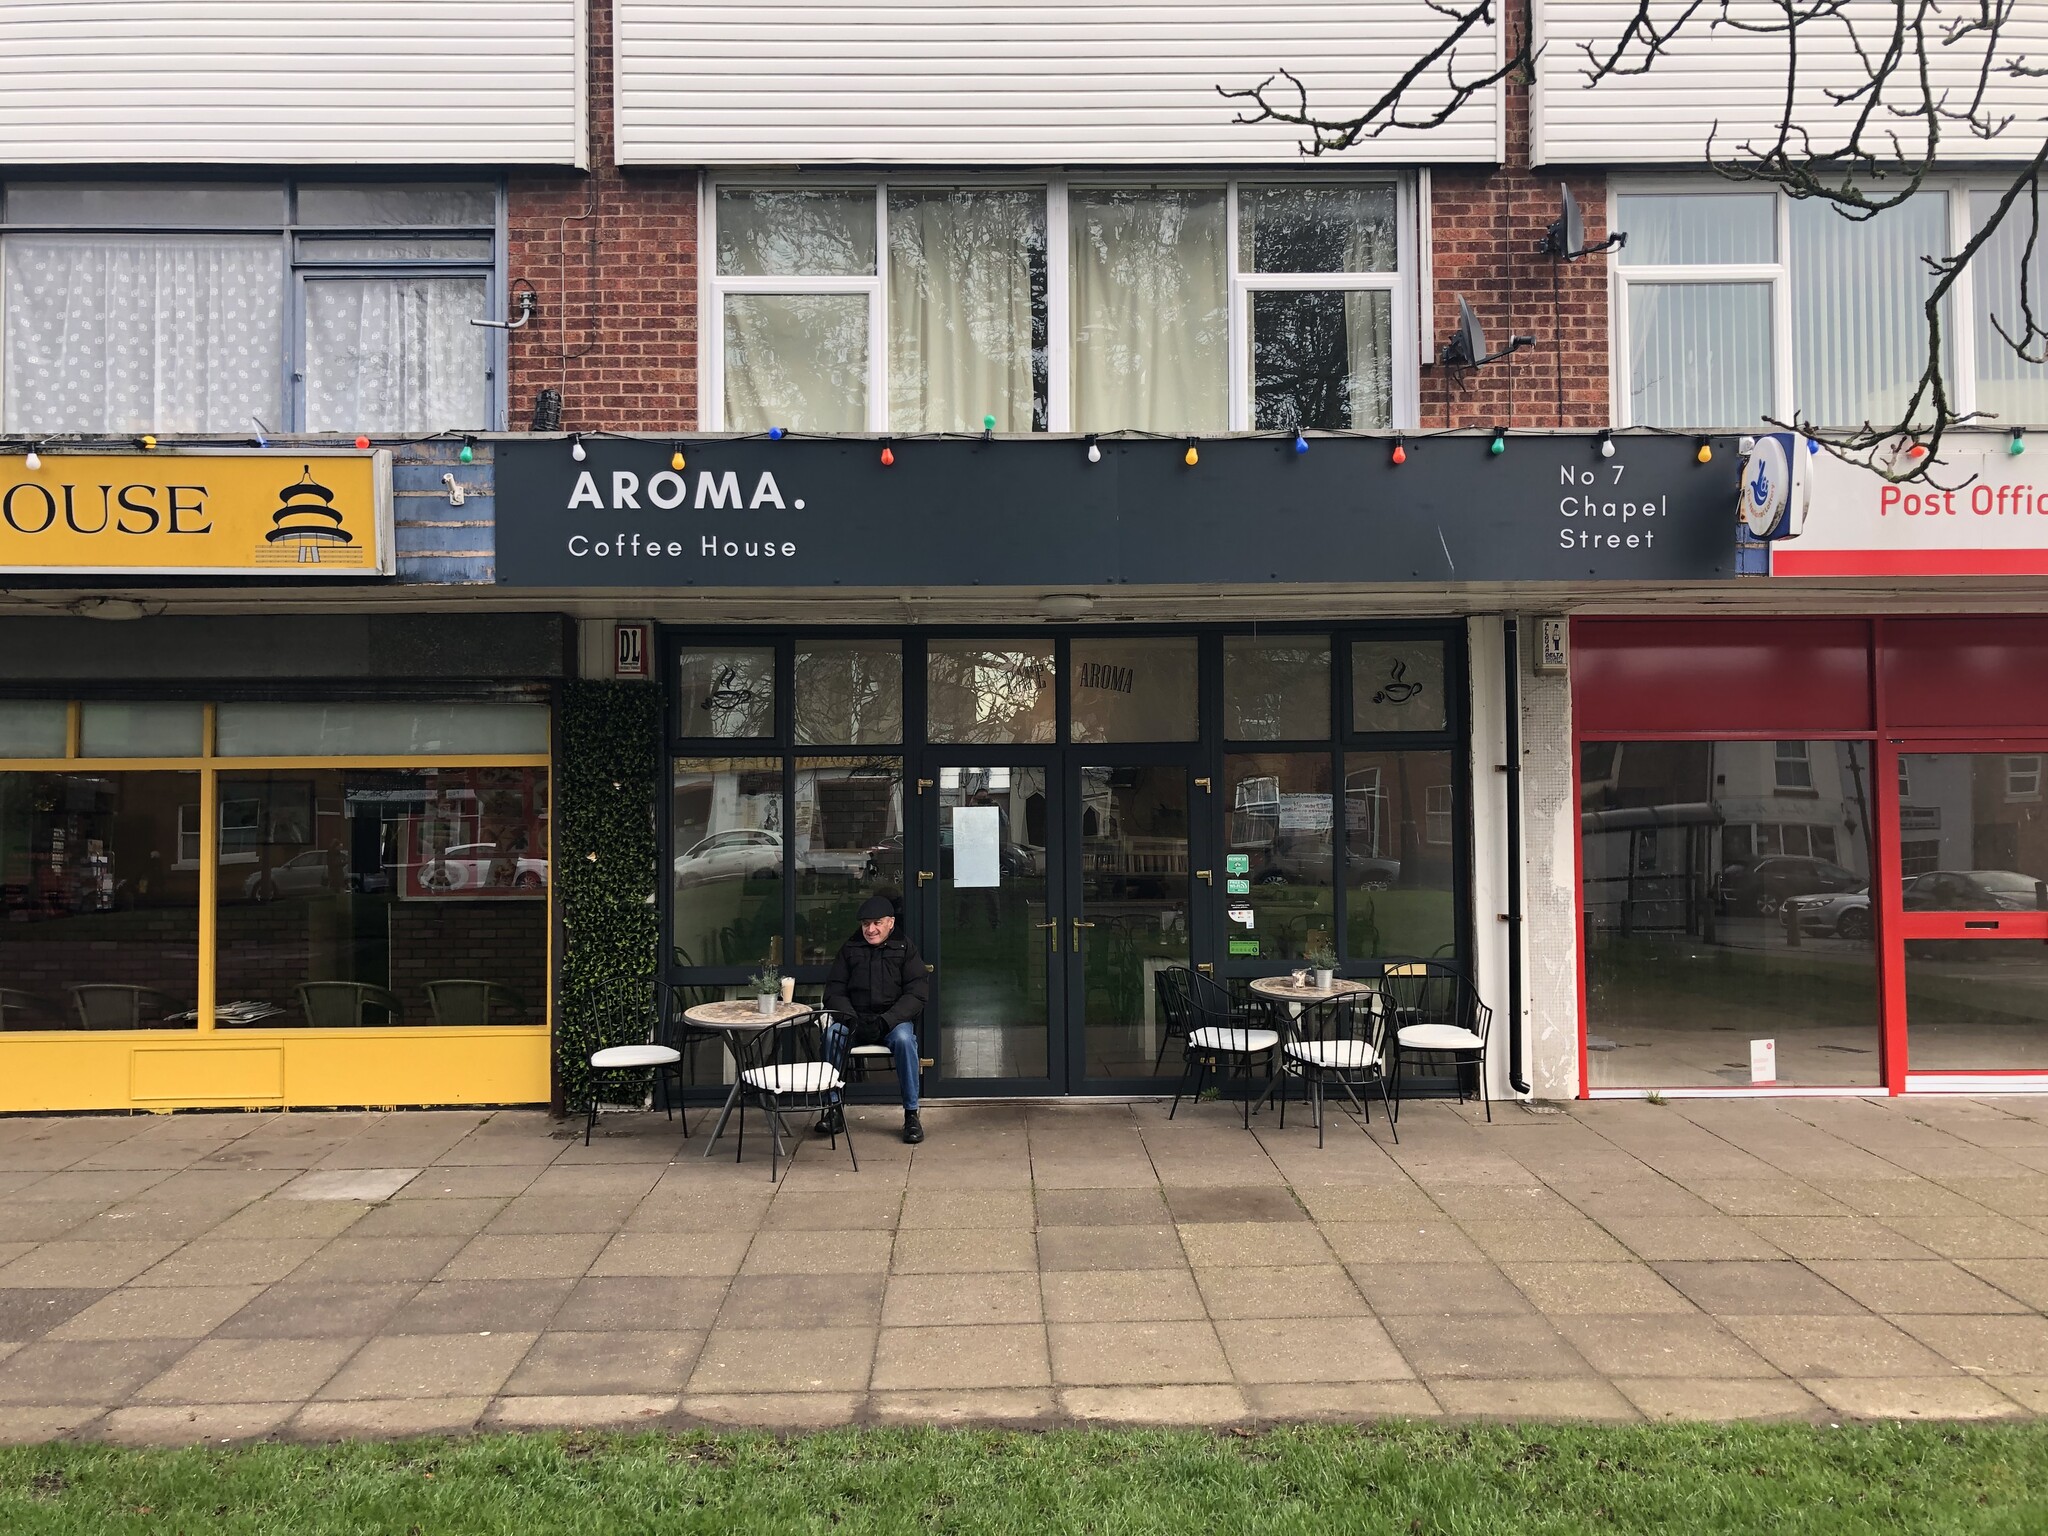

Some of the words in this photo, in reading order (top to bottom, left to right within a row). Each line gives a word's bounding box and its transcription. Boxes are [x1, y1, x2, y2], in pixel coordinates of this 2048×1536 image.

[567, 471, 806, 510] AROMA.
[1560, 465, 1595, 485] No
[1612, 465, 1625, 485] 7
[3, 483, 213, 534] OUSE
[1560, 495, 1666, 523] Chapel
[1880, 485, 1956, 516] Post
[568, 533, 683, 557] Coffee
[701, 535, 796, 557] House
[1560, 528, 1654, 549] Street
[620, 629, 640, 662] DL
[1080, 662, 1134, 694] AROMA
